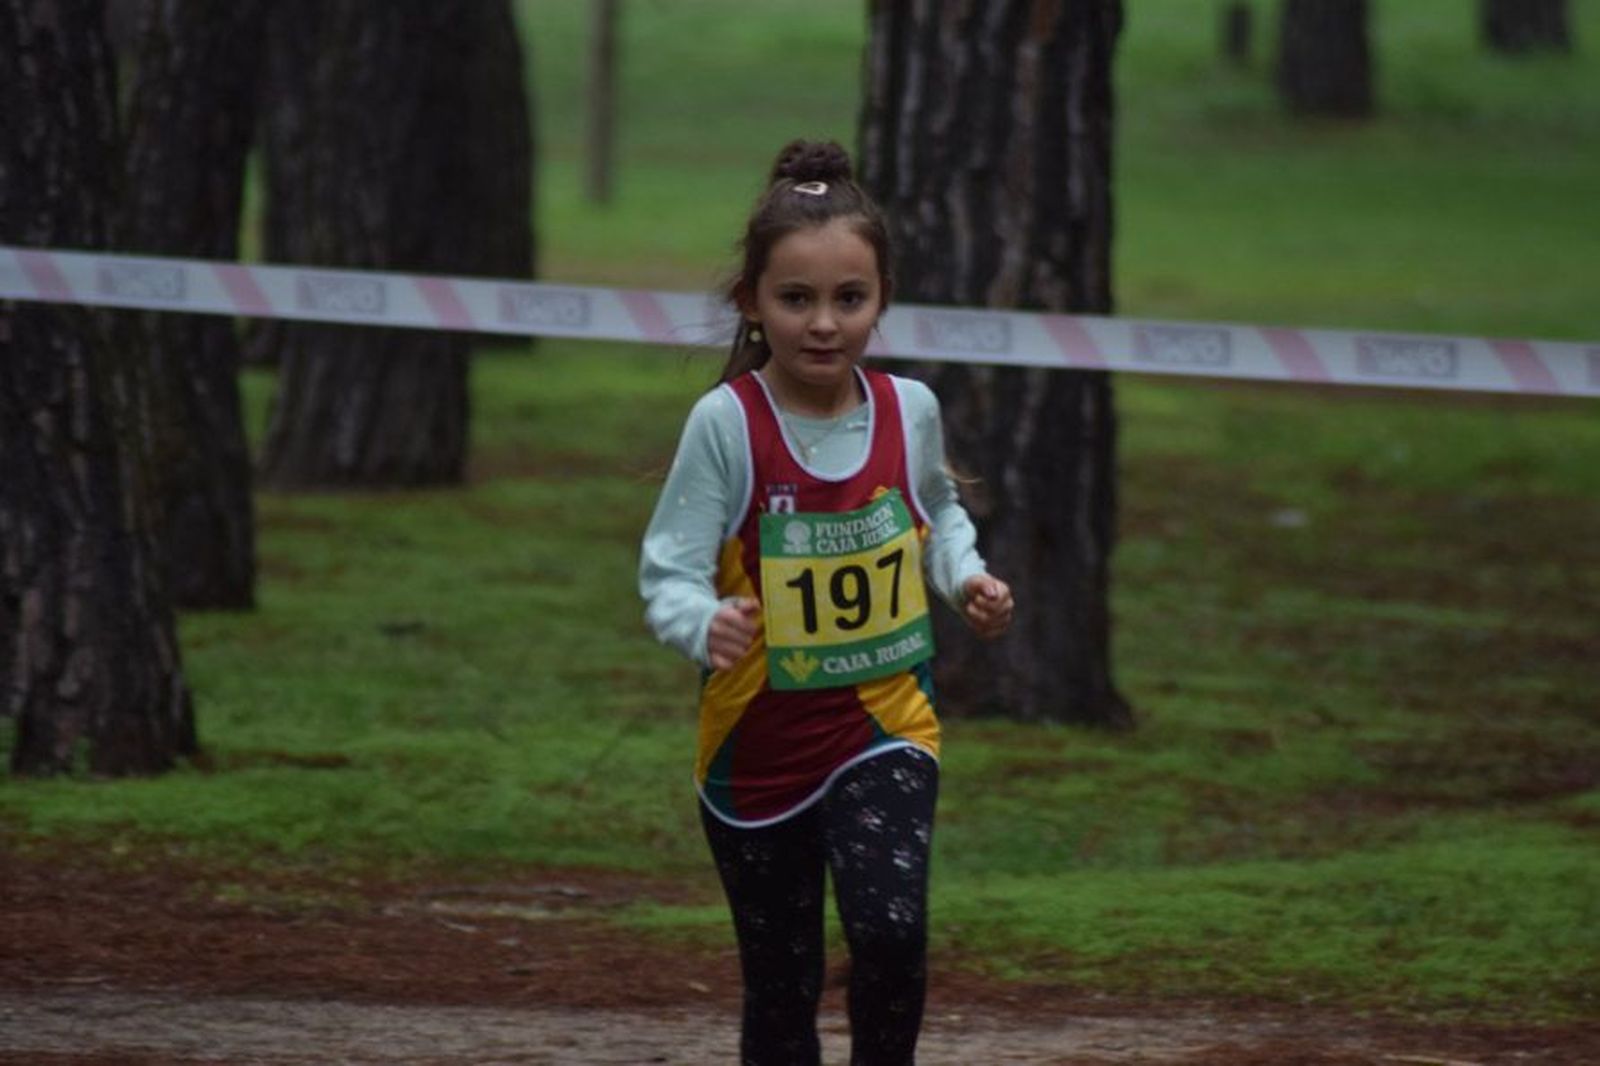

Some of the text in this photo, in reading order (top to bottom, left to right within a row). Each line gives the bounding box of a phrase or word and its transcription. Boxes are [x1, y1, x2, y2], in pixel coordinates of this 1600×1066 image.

[816, 538, 858, 554] CAJA
[786, 548, 904, 634] 197
[822, 632, 925, 674] CAJA RURAL
